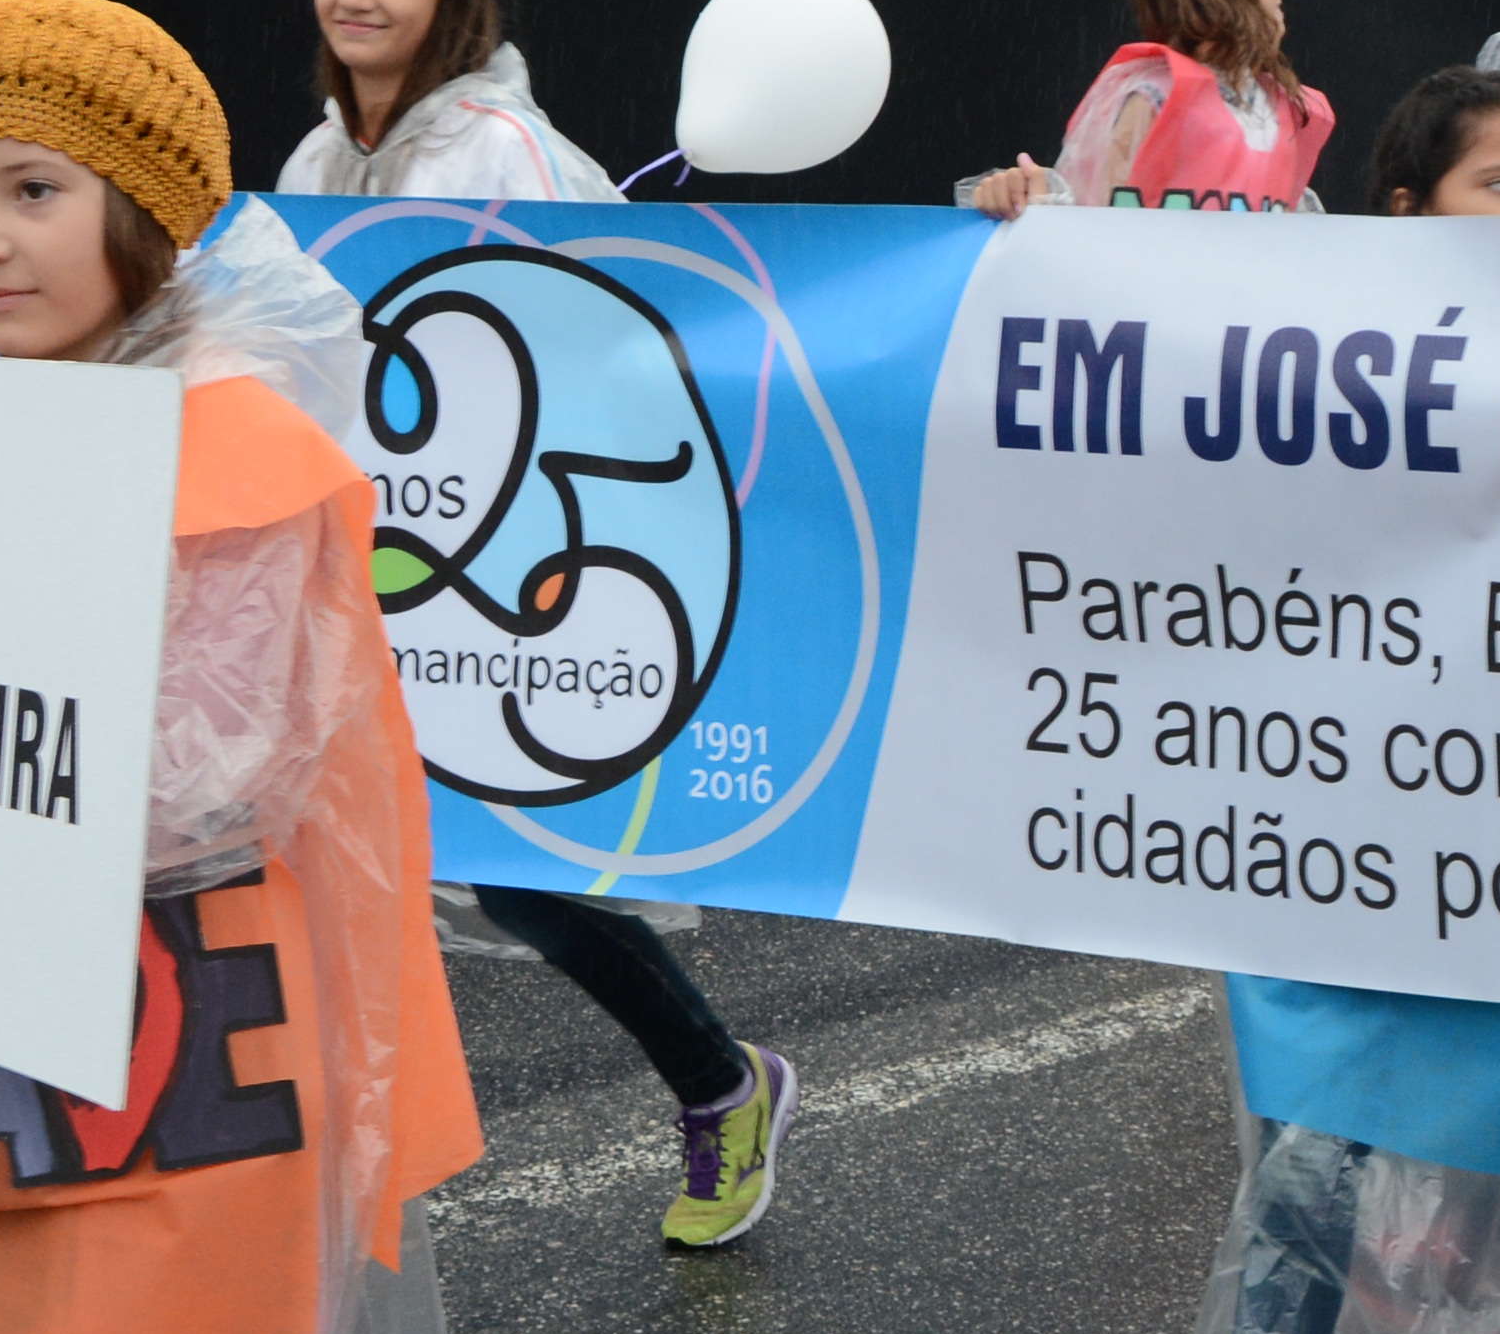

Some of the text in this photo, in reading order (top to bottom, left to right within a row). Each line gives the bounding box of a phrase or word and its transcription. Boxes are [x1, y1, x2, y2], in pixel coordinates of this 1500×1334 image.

[994, 316, 1148, 457] EM
[1182, 307, 1467, 474] JOSÉ
[367, 473, 467, 519] nos
[1016, 550, 1445, 684] Parabéns,
[389, 638, 663, 710] mancipação
[688, 721, 768, 764] 1991
[1025, 667, 1123, 759] 25
[1154, 697, 1350, 785] anos
[689, 764, 773, 805] 2016
[1026, 788, 1398, 911] cidadãos
